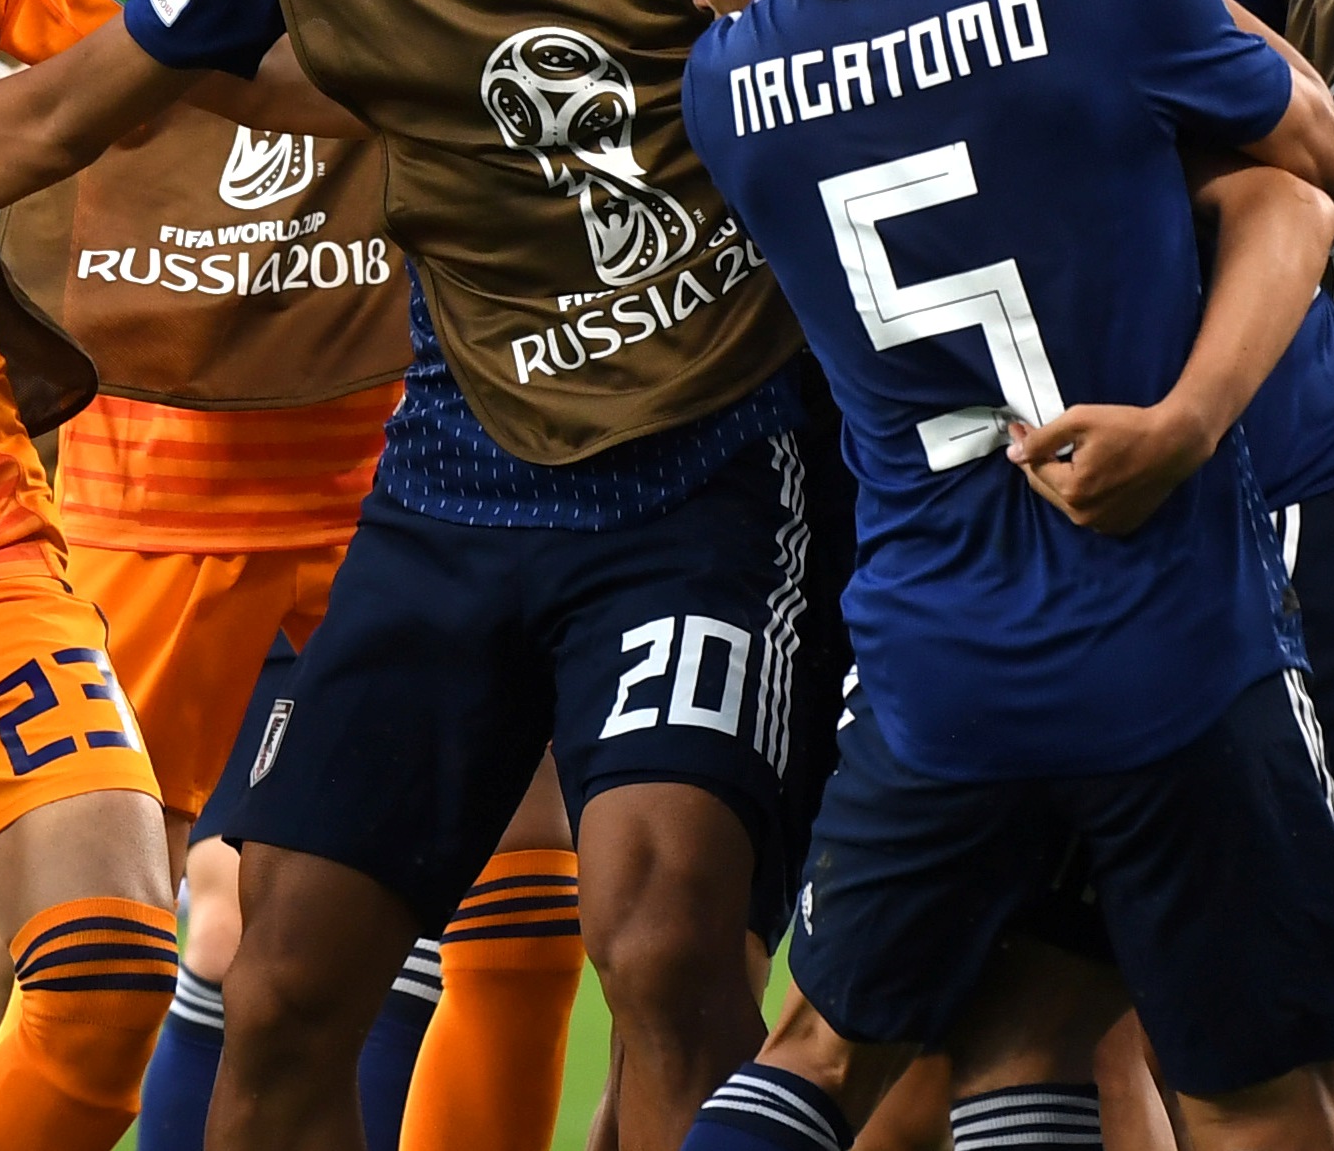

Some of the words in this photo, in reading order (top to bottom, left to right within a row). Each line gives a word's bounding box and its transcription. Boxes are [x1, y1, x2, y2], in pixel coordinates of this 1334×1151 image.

[77, 247, 282, 296] RUSSIA
[281, 237, 391, 289] 2018
[159, 224, 215, 248] FIFA
[217, 218, 303, 246] WORLD
[511, 270, 716, 385] RUSSIA
[818, 140, 1074, 473] 5
[598, 614, 751, 740] 20
